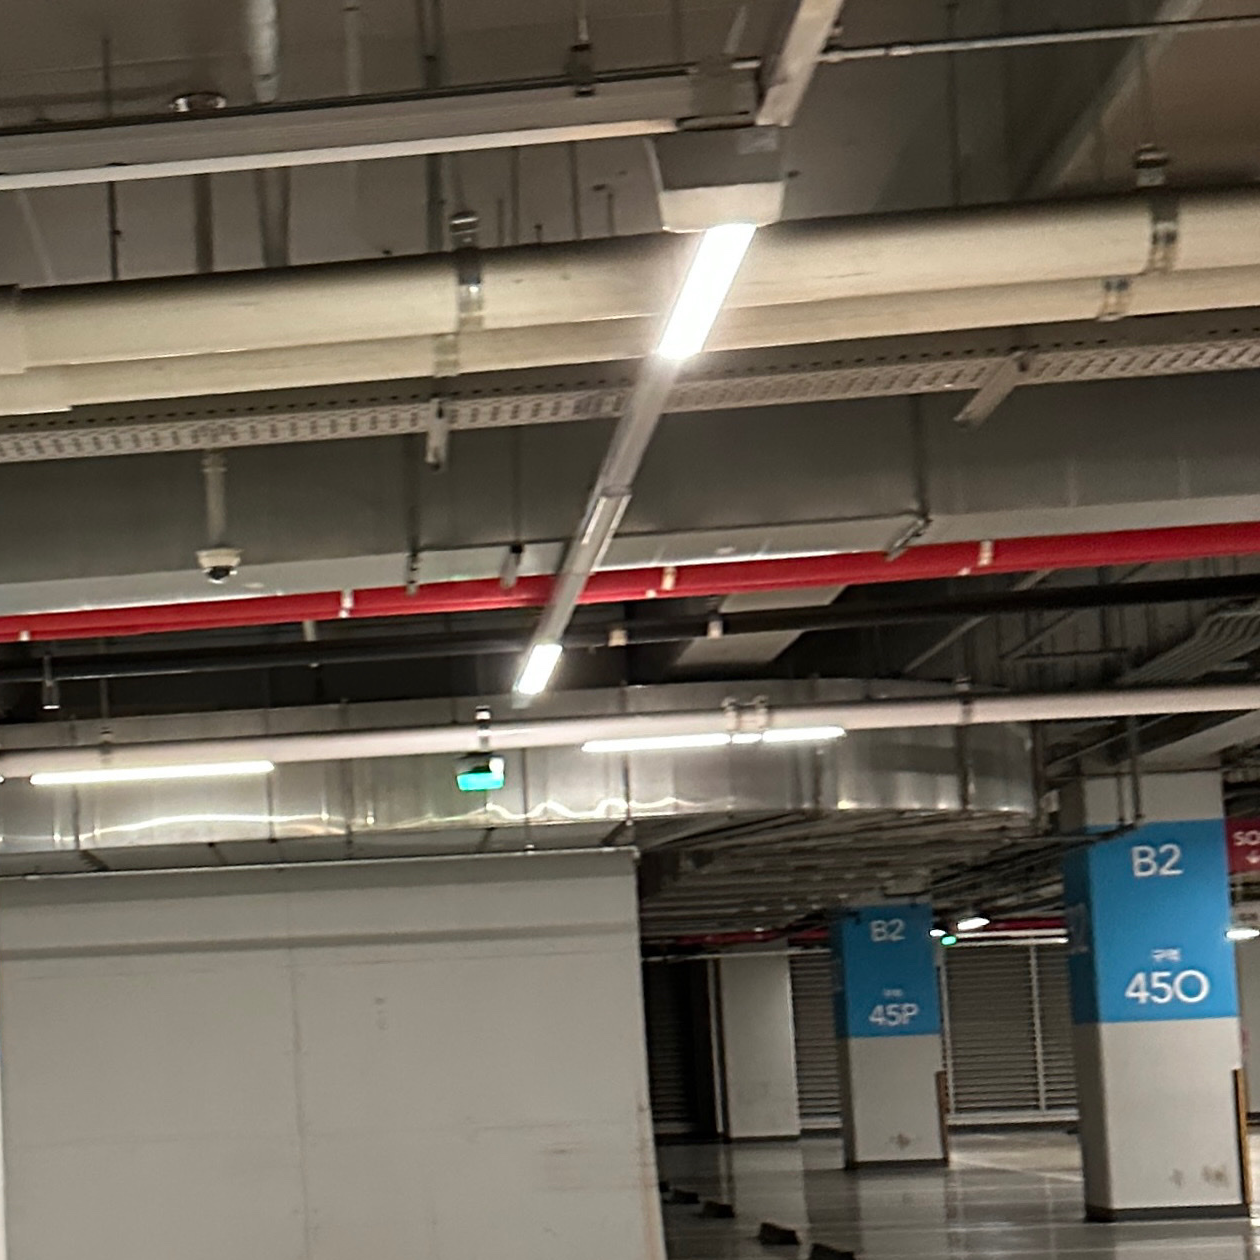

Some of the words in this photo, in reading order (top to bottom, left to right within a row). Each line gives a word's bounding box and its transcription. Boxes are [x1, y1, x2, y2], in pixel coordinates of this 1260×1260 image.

[1131, 844, 1184, 877] B2
[870, 918, 905, 942] B2
[869, 1003, 918, 1026] 45P
